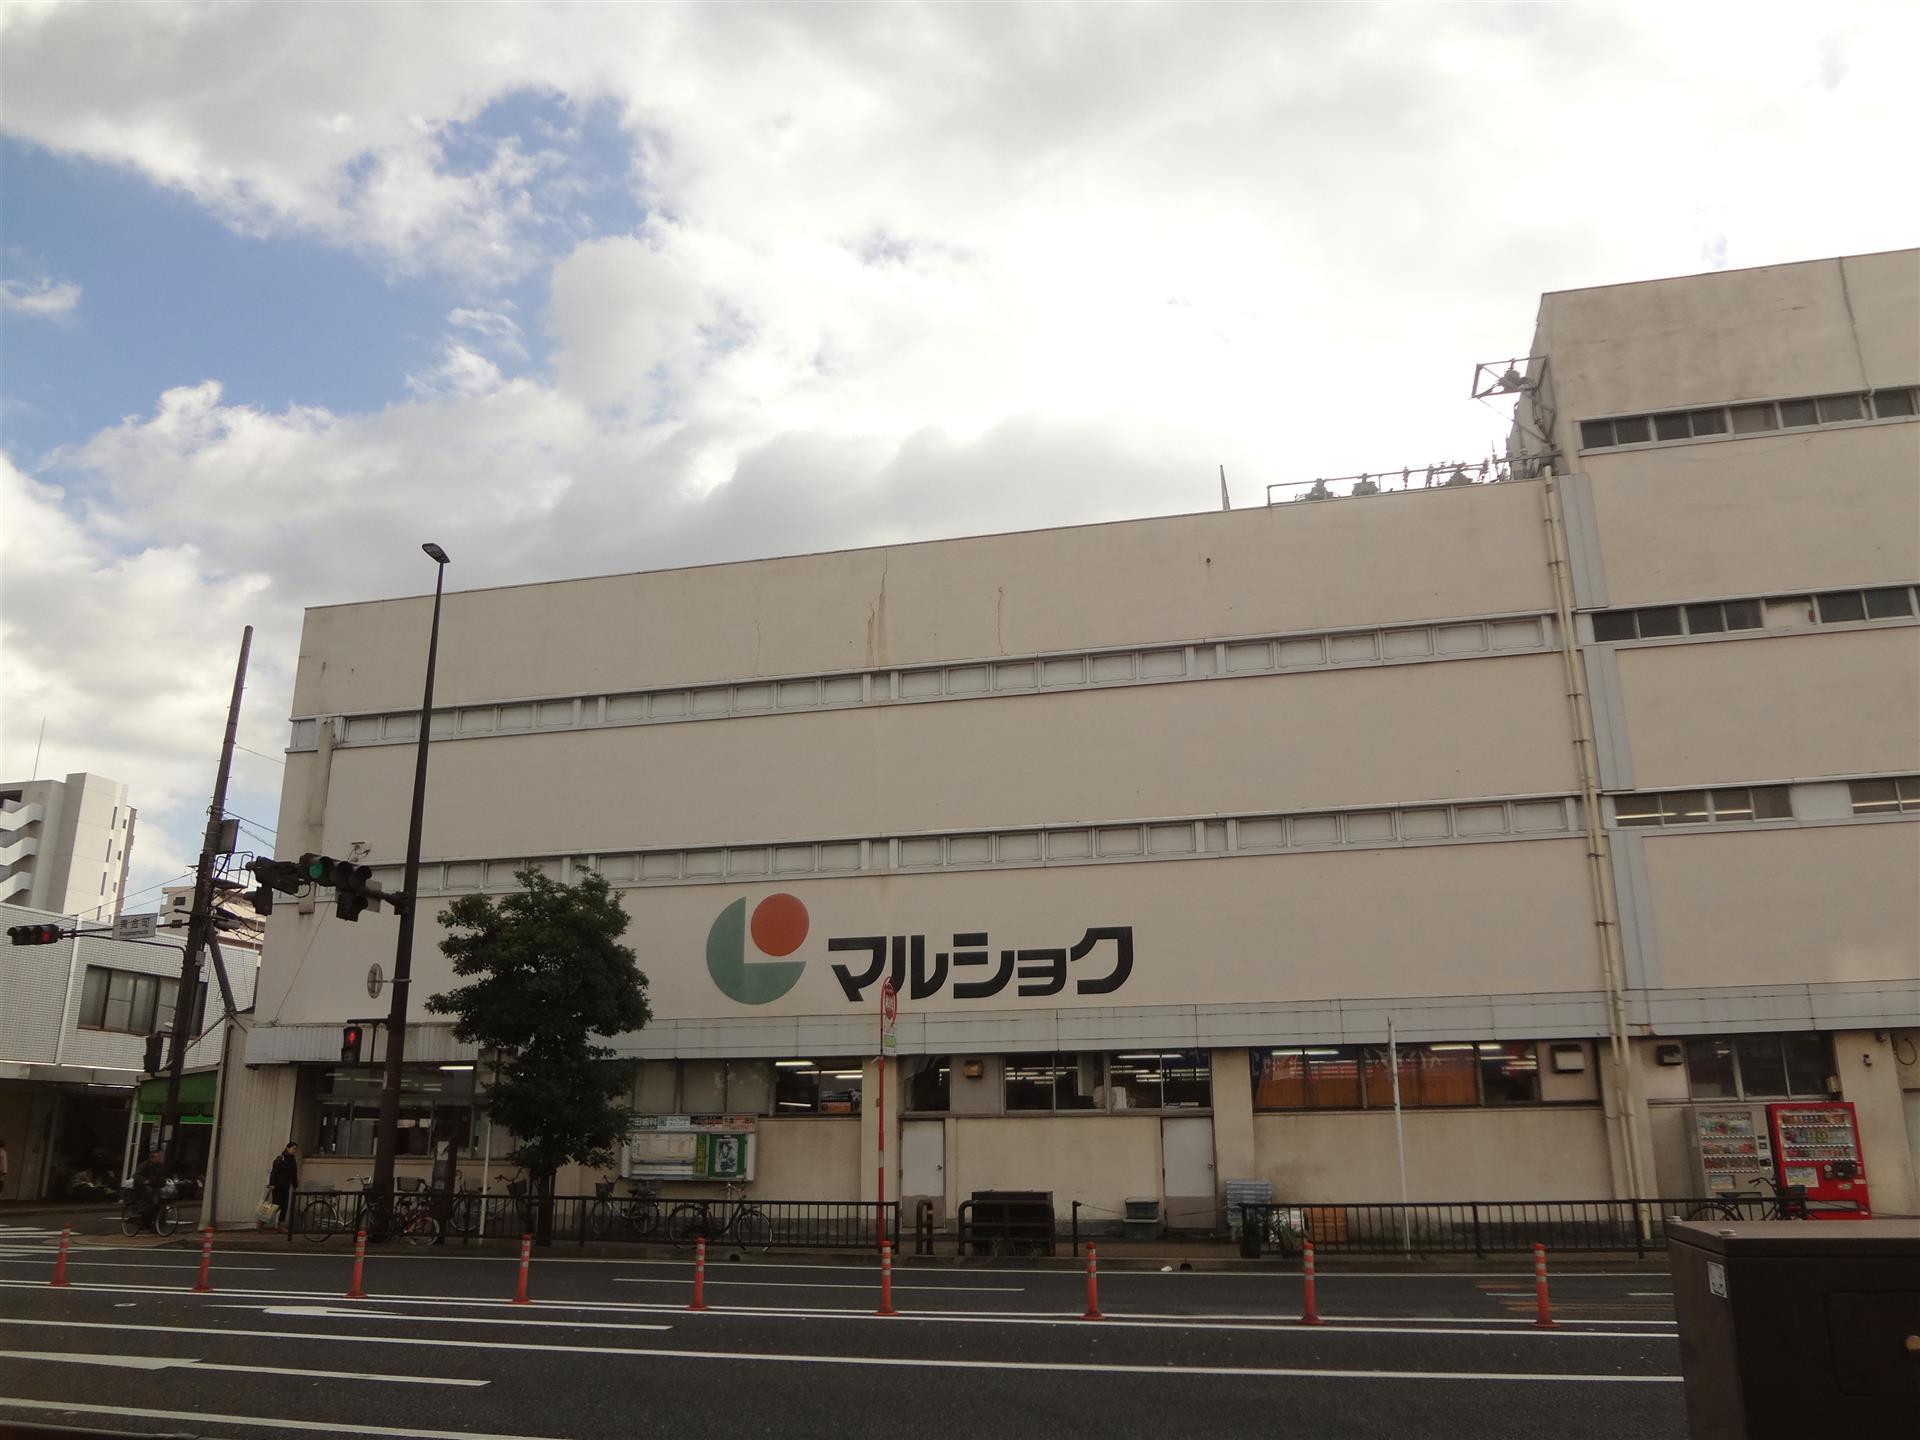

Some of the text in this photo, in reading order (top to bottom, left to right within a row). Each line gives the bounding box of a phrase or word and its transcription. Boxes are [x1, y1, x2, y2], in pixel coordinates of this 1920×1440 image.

[828, 926, 1133, 1002] マルショク
